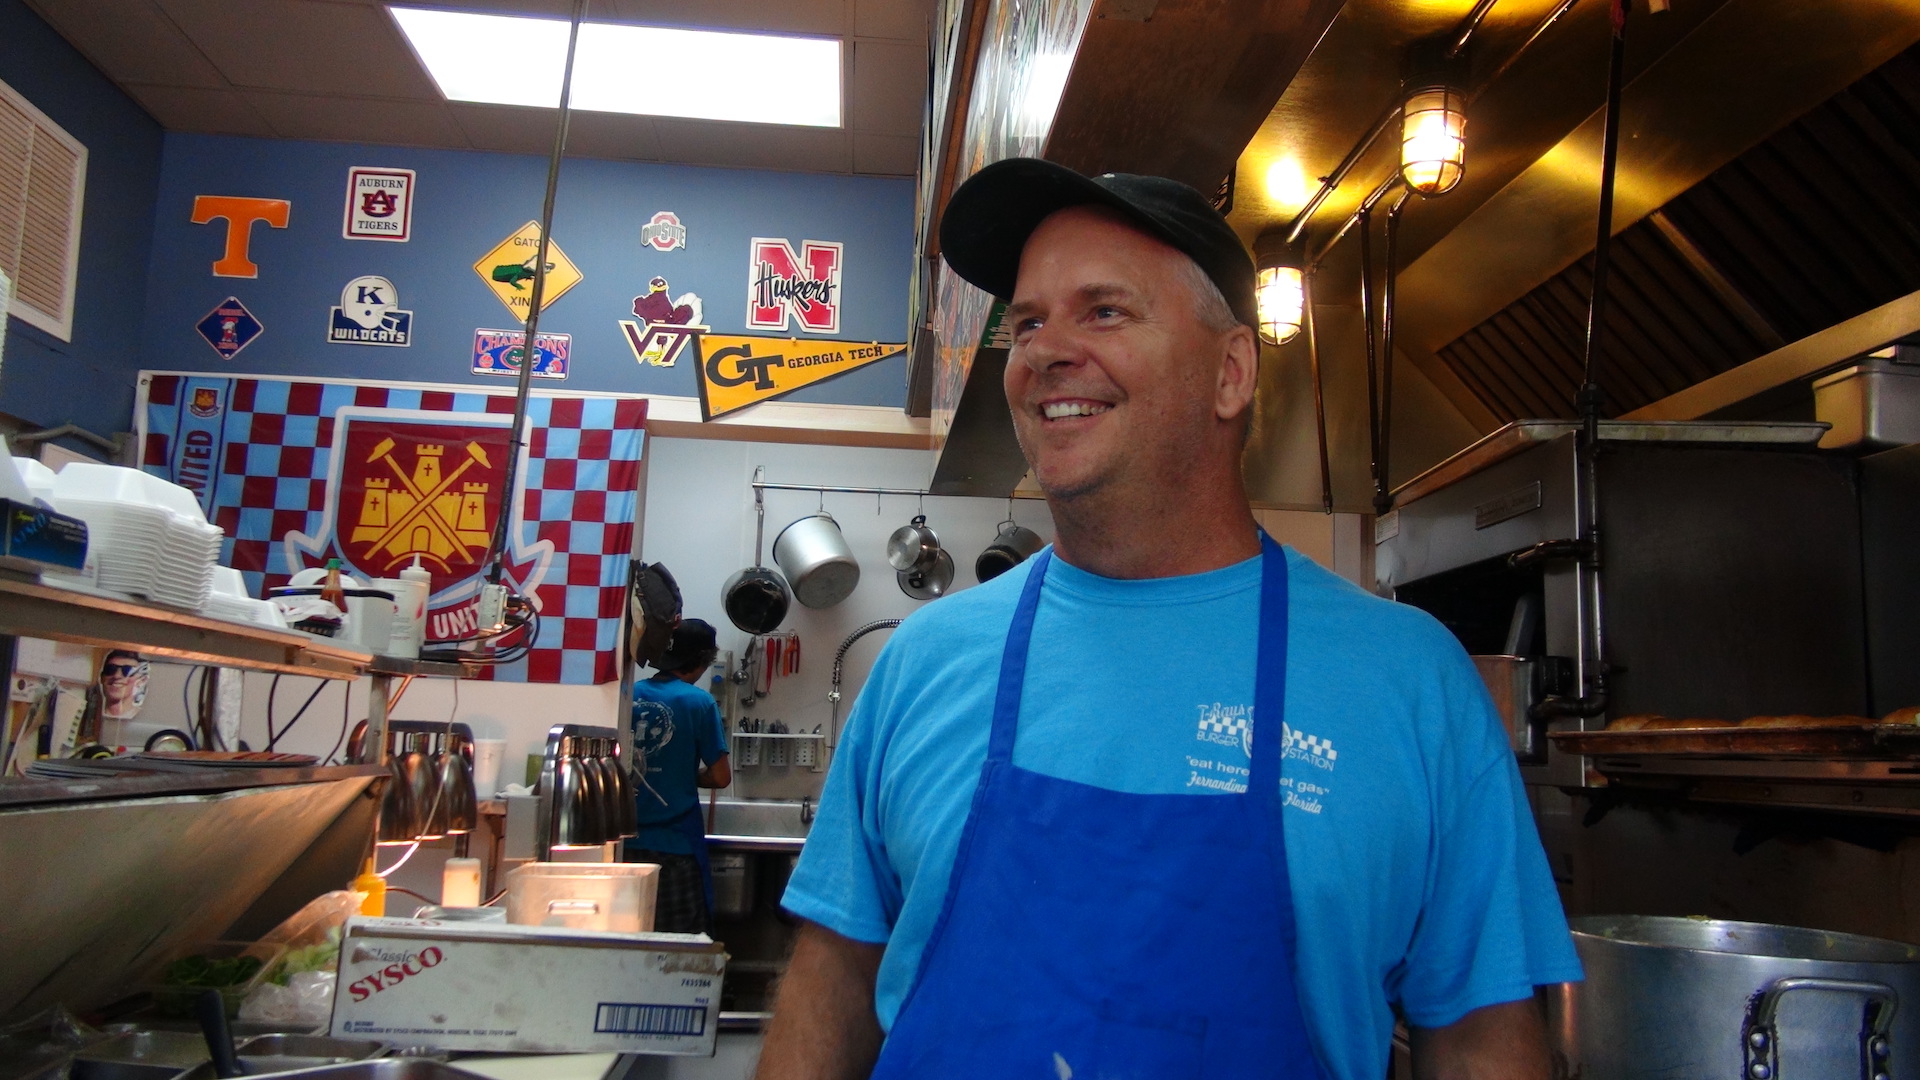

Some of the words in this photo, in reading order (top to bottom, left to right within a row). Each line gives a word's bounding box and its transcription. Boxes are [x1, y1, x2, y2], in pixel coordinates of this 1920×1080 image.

[358, 178, 404, 189] AUBURN
[190, 194, 292, 279] T
[357, 220, 399, 231] TIGERS
[514, 236, 541, 248] GATO
[355, 285, 385, 305] K
[754, 260, 837, 311] Huskers
[509, 296, 530, 307] XIN
[334, 327, 406, 343] WILDCATS
[477, 335, 567, 360] CHAMPONS
[705, 343, 785, 392] GT
[788, 351, 845, 369] GEORGIA
[848, 345, 884, 360] TECH
[178, 429, 213, 499] NITED
[1196, 730, 1240, 748] BURGER
[1288, 747, 1335, 772] STATION
[1216, 760, 1251, 777] here
[1279, 777, 1294, 788] et
[1186, 770, 1249, 794] Fernandina
[1282, 790, 1323, 814] Florida
[371, 947, 418, 963] lassic
[348, 945, 443, 1003] SYSCO
